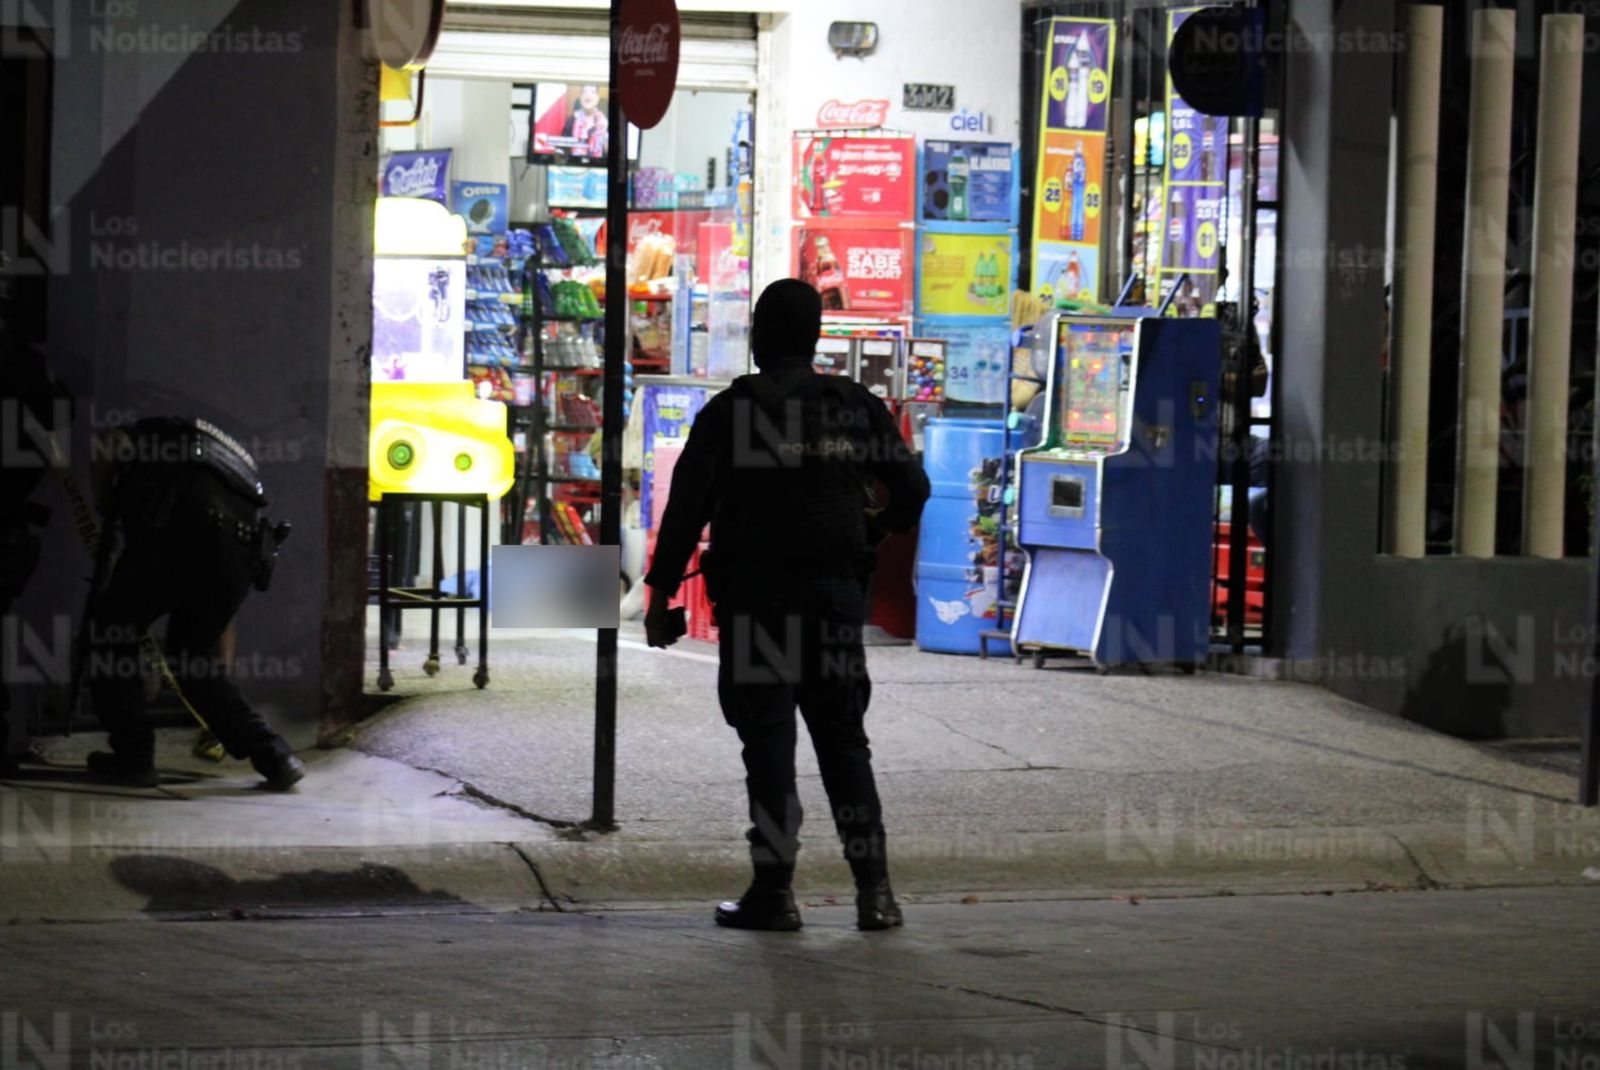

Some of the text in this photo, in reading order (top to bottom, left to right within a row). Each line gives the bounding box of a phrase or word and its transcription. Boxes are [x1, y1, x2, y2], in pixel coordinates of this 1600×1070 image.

[618, 23, 672, 65] Coca-Cola
[820, 100, 888, 124] Coca-Cola
[950, 106, 984, 132] ciel
[1045, 187, 1061, 202] 25
[848, 254, 901, 271] SABE
